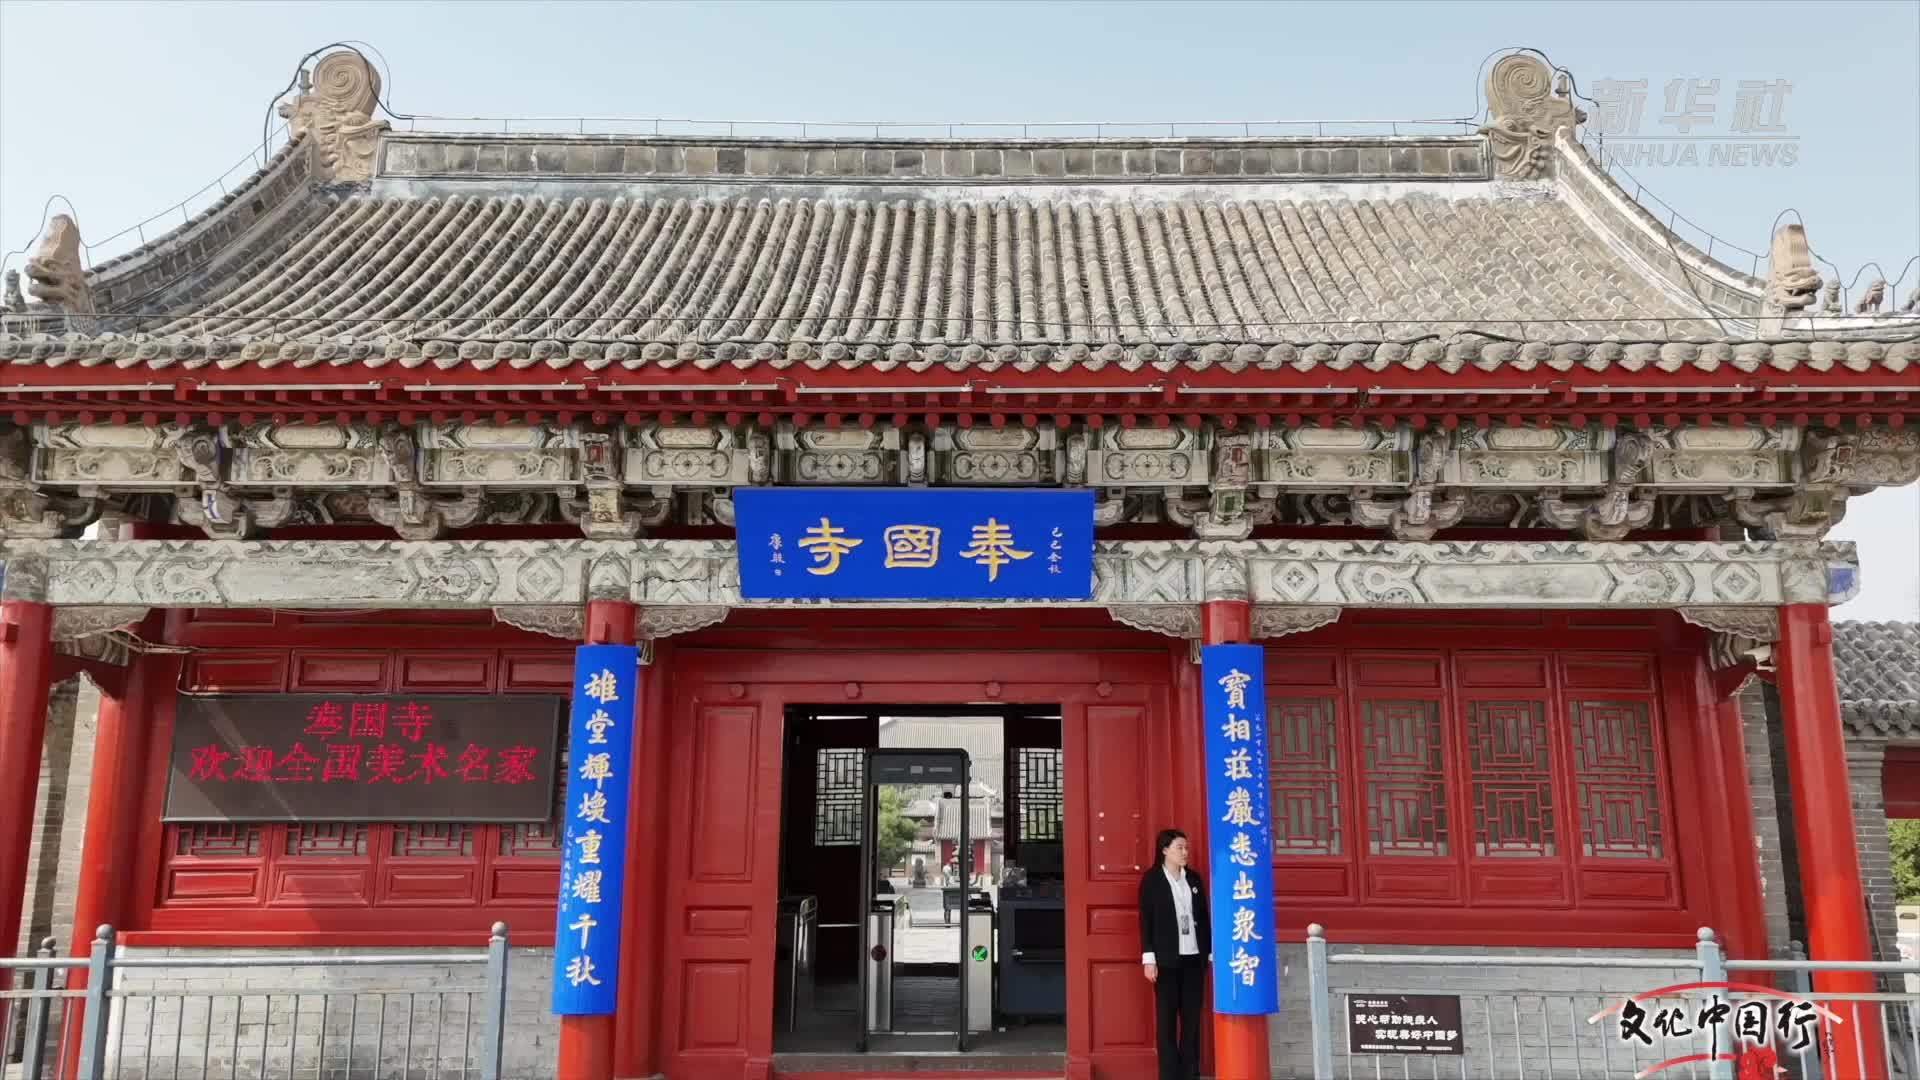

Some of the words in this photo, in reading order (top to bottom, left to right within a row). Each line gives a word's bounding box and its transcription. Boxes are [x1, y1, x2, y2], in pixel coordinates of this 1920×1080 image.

[189, 743, 538, 783] 欢迎全国美术名家
